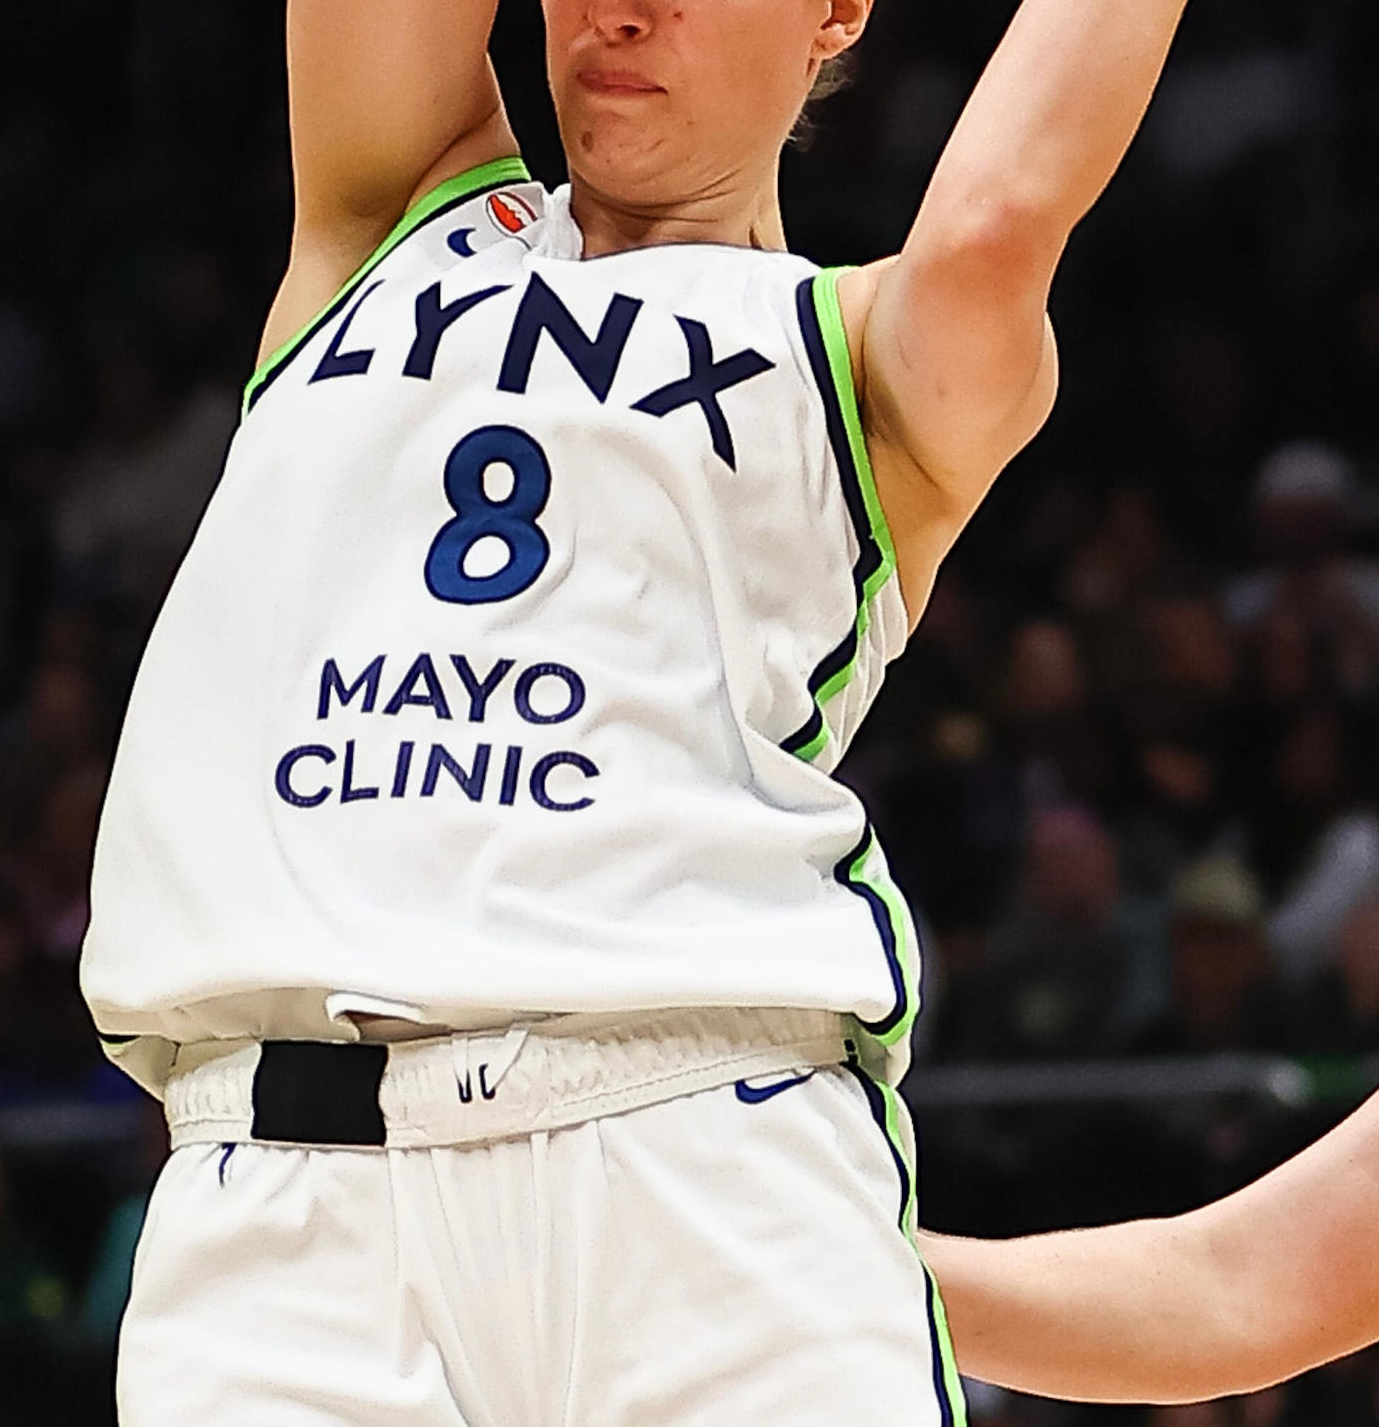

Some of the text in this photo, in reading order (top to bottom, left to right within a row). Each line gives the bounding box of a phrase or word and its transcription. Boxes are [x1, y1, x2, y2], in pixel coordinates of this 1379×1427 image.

[307, 271, 777, 473] LYNX
[423, 424, 552, 606] 8
[317, 653, 586, 725] MAYO
[275, 739, 600, 812] CLINIC
